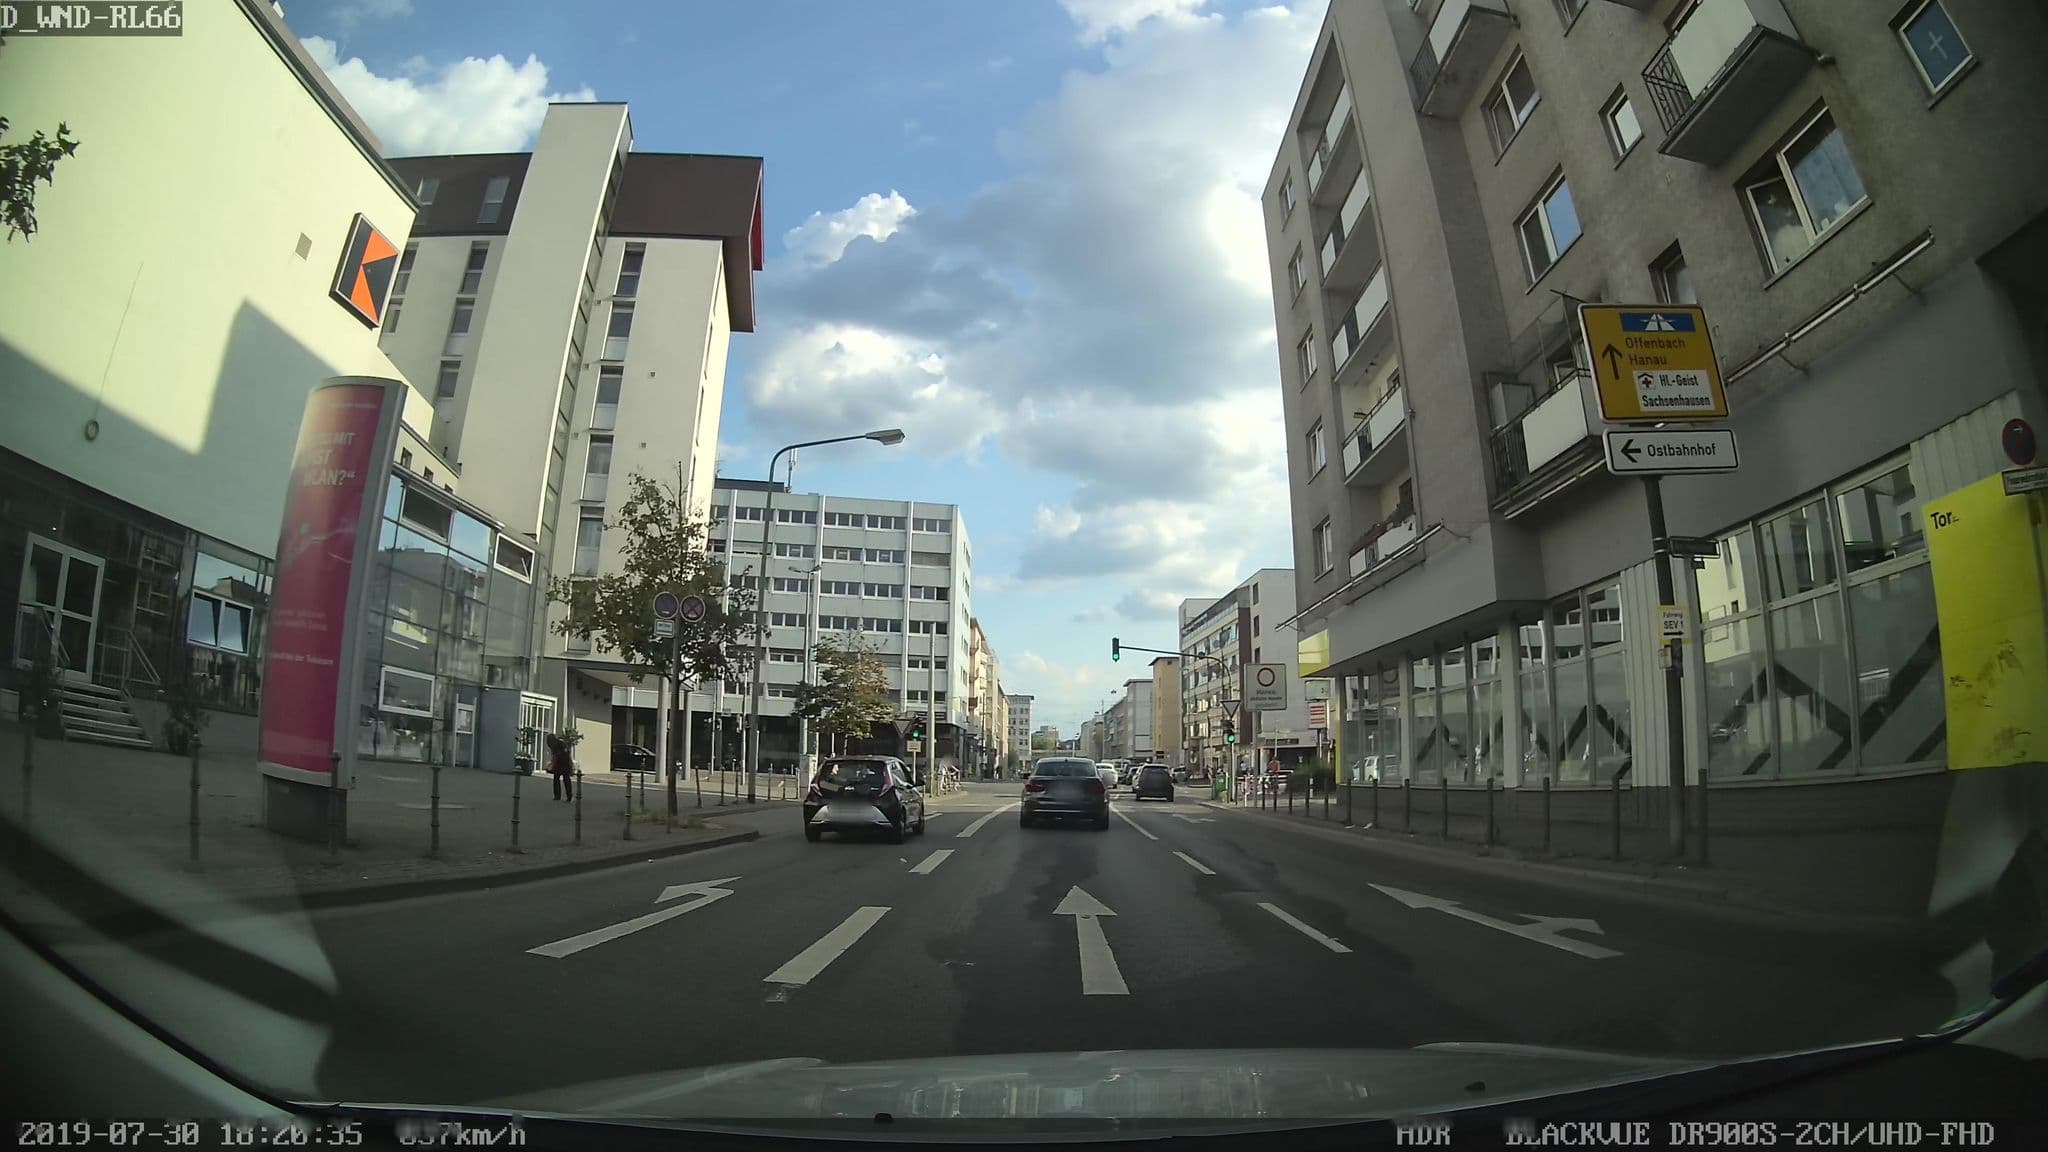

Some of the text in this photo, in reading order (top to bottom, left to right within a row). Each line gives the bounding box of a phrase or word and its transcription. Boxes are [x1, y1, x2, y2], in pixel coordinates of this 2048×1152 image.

[1625, 337, 1686, 350] Offenbach
[1629, 354, 1668, 366] Hanau
[1642, 394, 1711, 408] Sachsenhausen
[1647, 442, 1717, 457] Ostbahnhof
